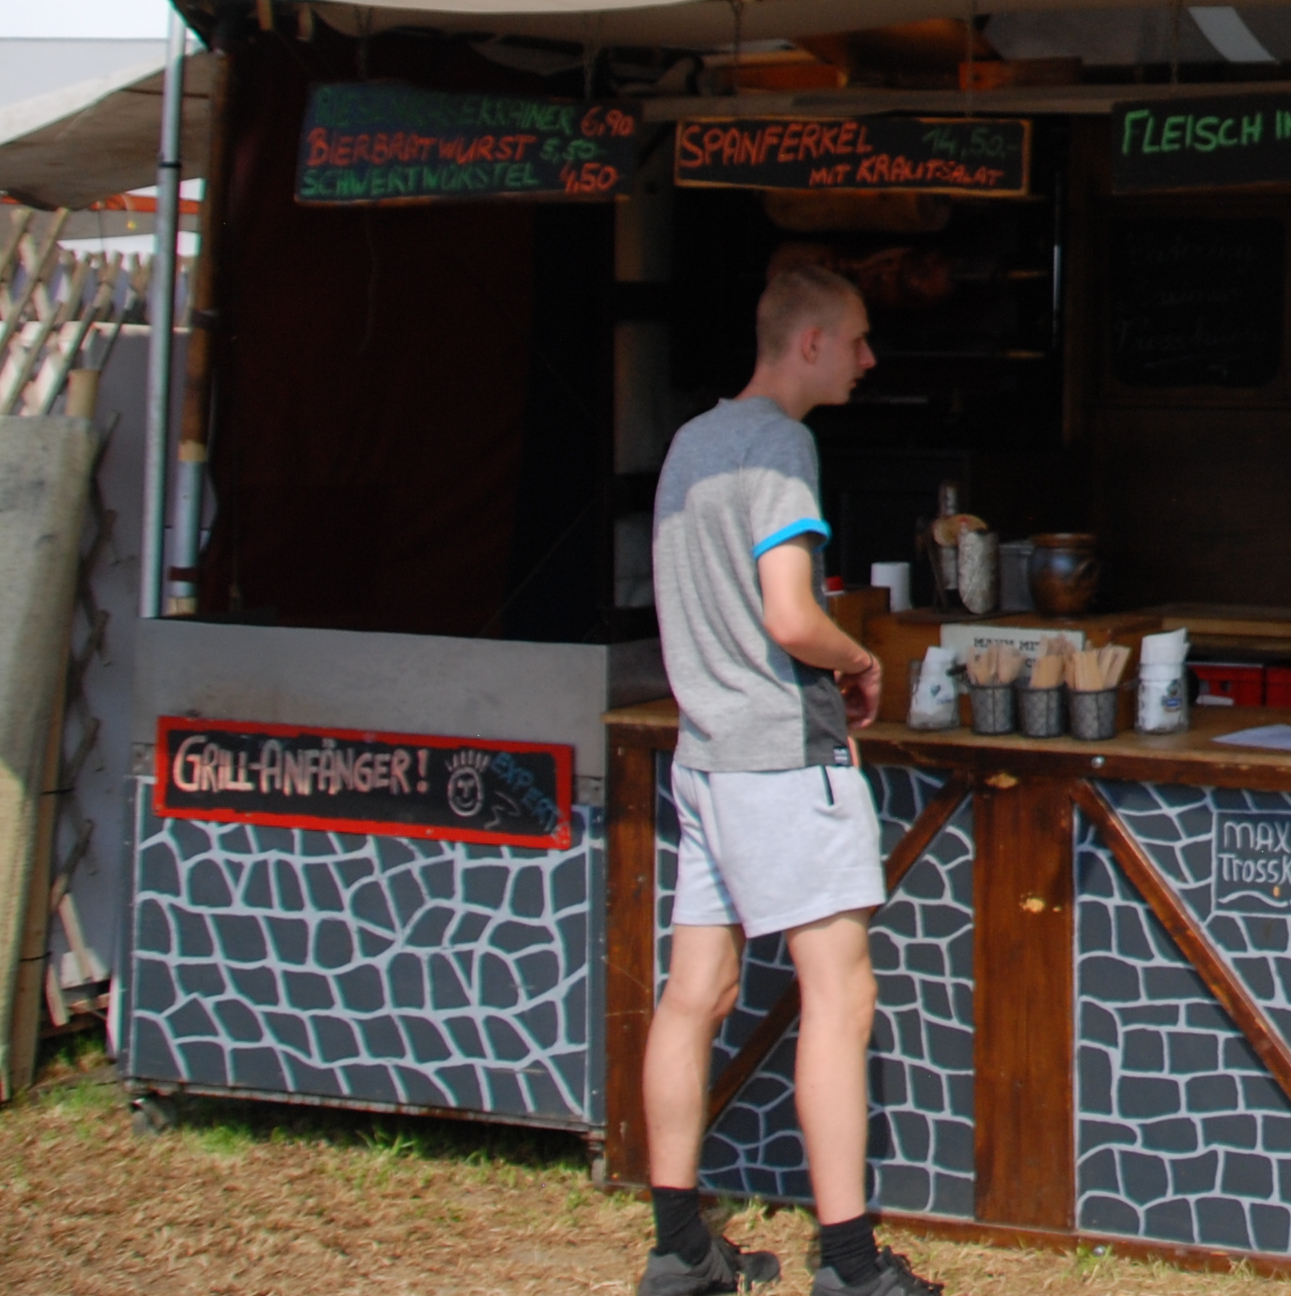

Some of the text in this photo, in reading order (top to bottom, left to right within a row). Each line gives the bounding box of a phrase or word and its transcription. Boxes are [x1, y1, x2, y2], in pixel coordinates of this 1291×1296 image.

[680, 121, 873, 168] SPANFERKEL
[1122, 108, 1262, 155] FLEISCH
[809, 155, 1004, 187] MIT KRAUTSALAT
